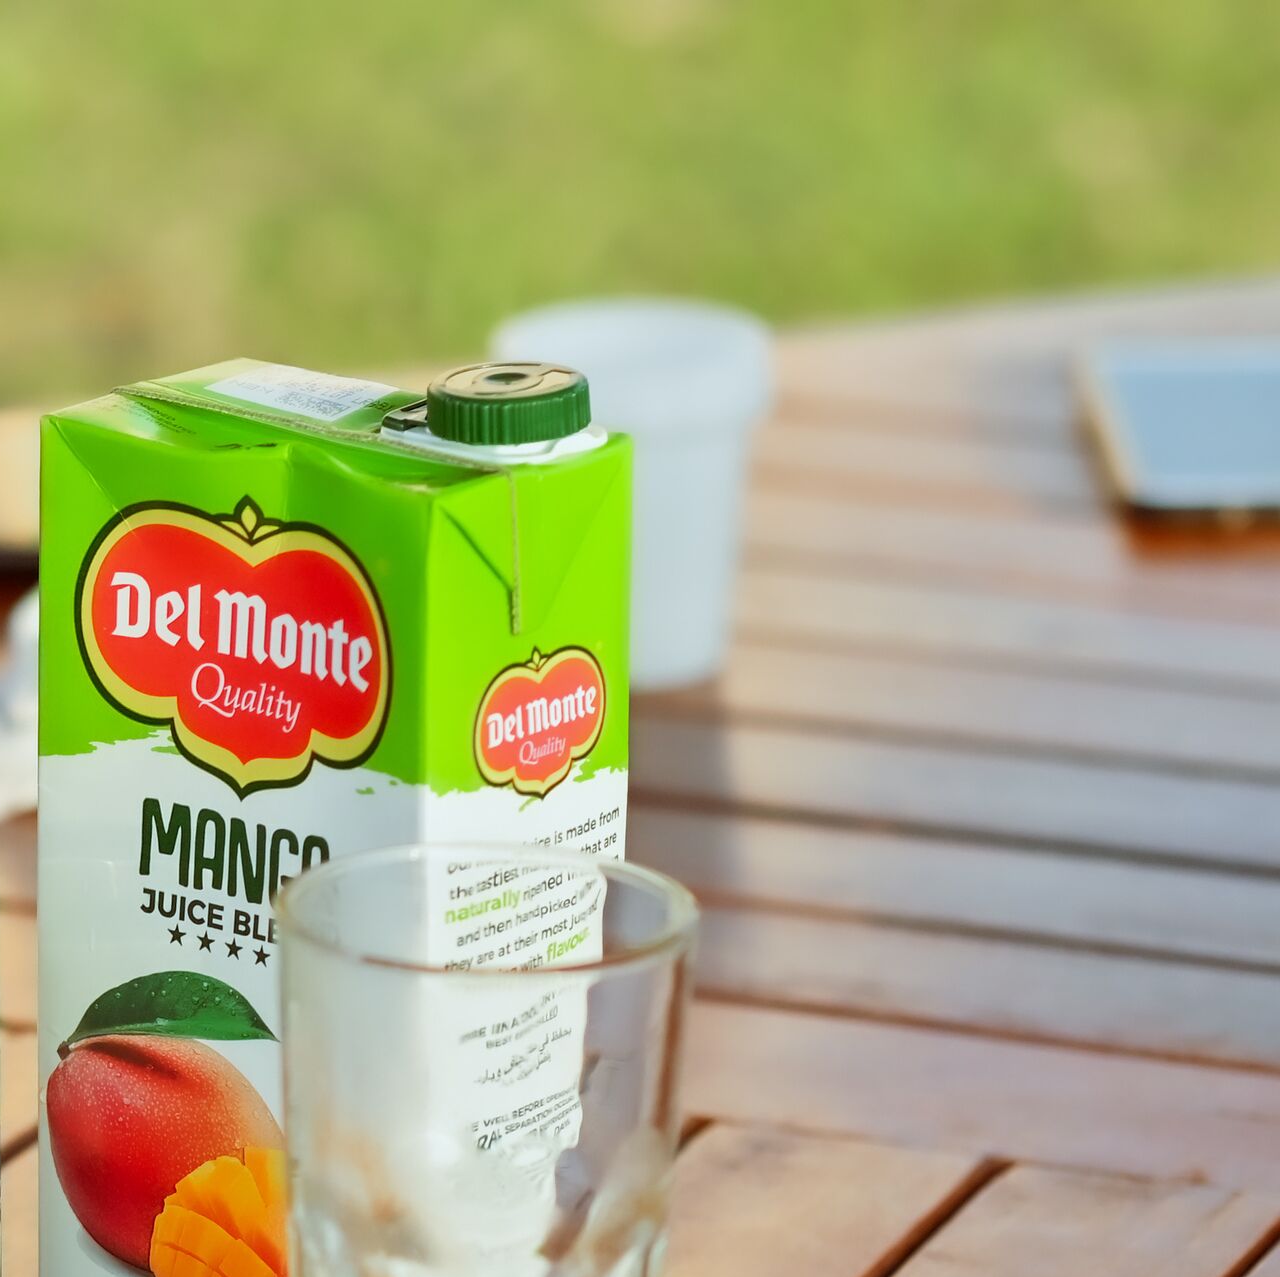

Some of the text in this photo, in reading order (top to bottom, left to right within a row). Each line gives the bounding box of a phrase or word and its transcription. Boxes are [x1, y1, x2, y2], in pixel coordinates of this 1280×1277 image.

[111, 572, 372, 693] Del Monte
[191, 662, 301, 733] Quality
[487, 685, 596, 749] Del Monte
[519, 737, 566, 765] Quality
[554, 831, 563, 844] is
[566, 818, 597, 838] made
[599, 806, 620, 827] from
[604, 832, 618, 848] are
[140, 888, 277, 944] JUICE BLE
[444, 890, 521, 924] naturally
[456, 894, 578, 947] and then handpicked
[477, 950, 496, 965] are
[498, 944, 511, 958] at
[514, 932, 539, 951] their
[541, 919, 568, 940] most
